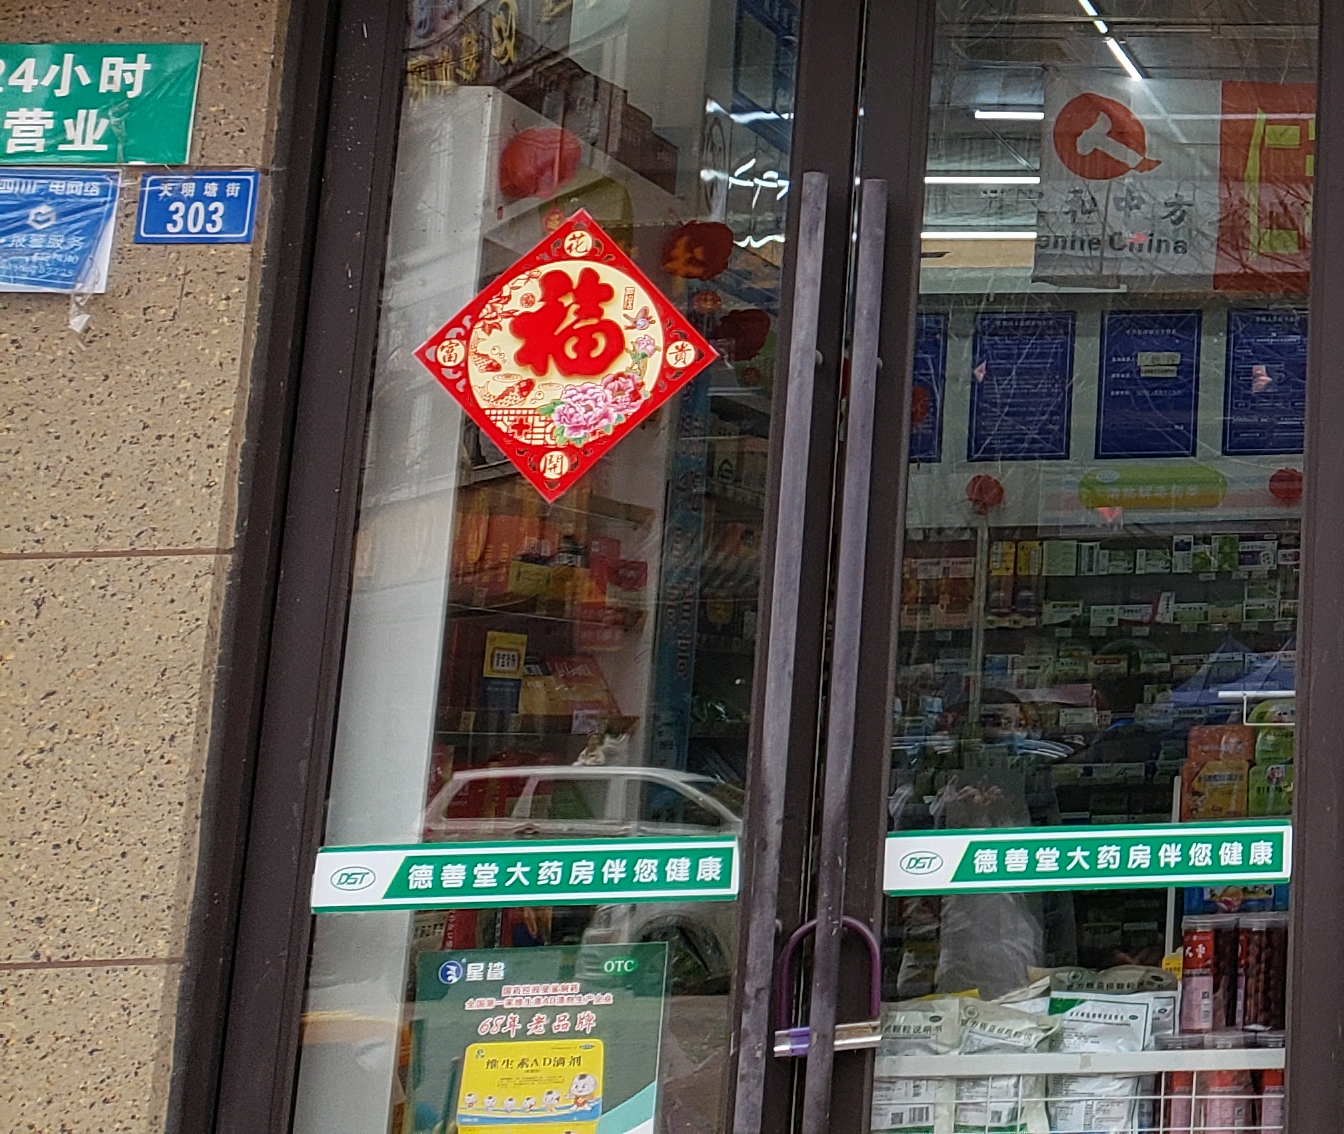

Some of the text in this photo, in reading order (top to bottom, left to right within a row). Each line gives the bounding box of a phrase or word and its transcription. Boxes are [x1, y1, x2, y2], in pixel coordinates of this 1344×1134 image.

[0, 53, 152, 98] 4小时
[3, 107, 110, 153] 营业
[158, 182, 241, 198] 天明塘街
[166, 201, 225, 233] 303
[509, 267, 626, 377] 福
[407, 855, 725, 892] 德善堂大药房伴您健康
[904, 854, 940, 872] DST
[972, 841, 1276, 876] 德善堂大药房伴您健康
[335, 870, 371, 886] DST
[603, 960, 635, 973] OTC
[484, 1054, 583, 1071] 维生素AD滴剂
